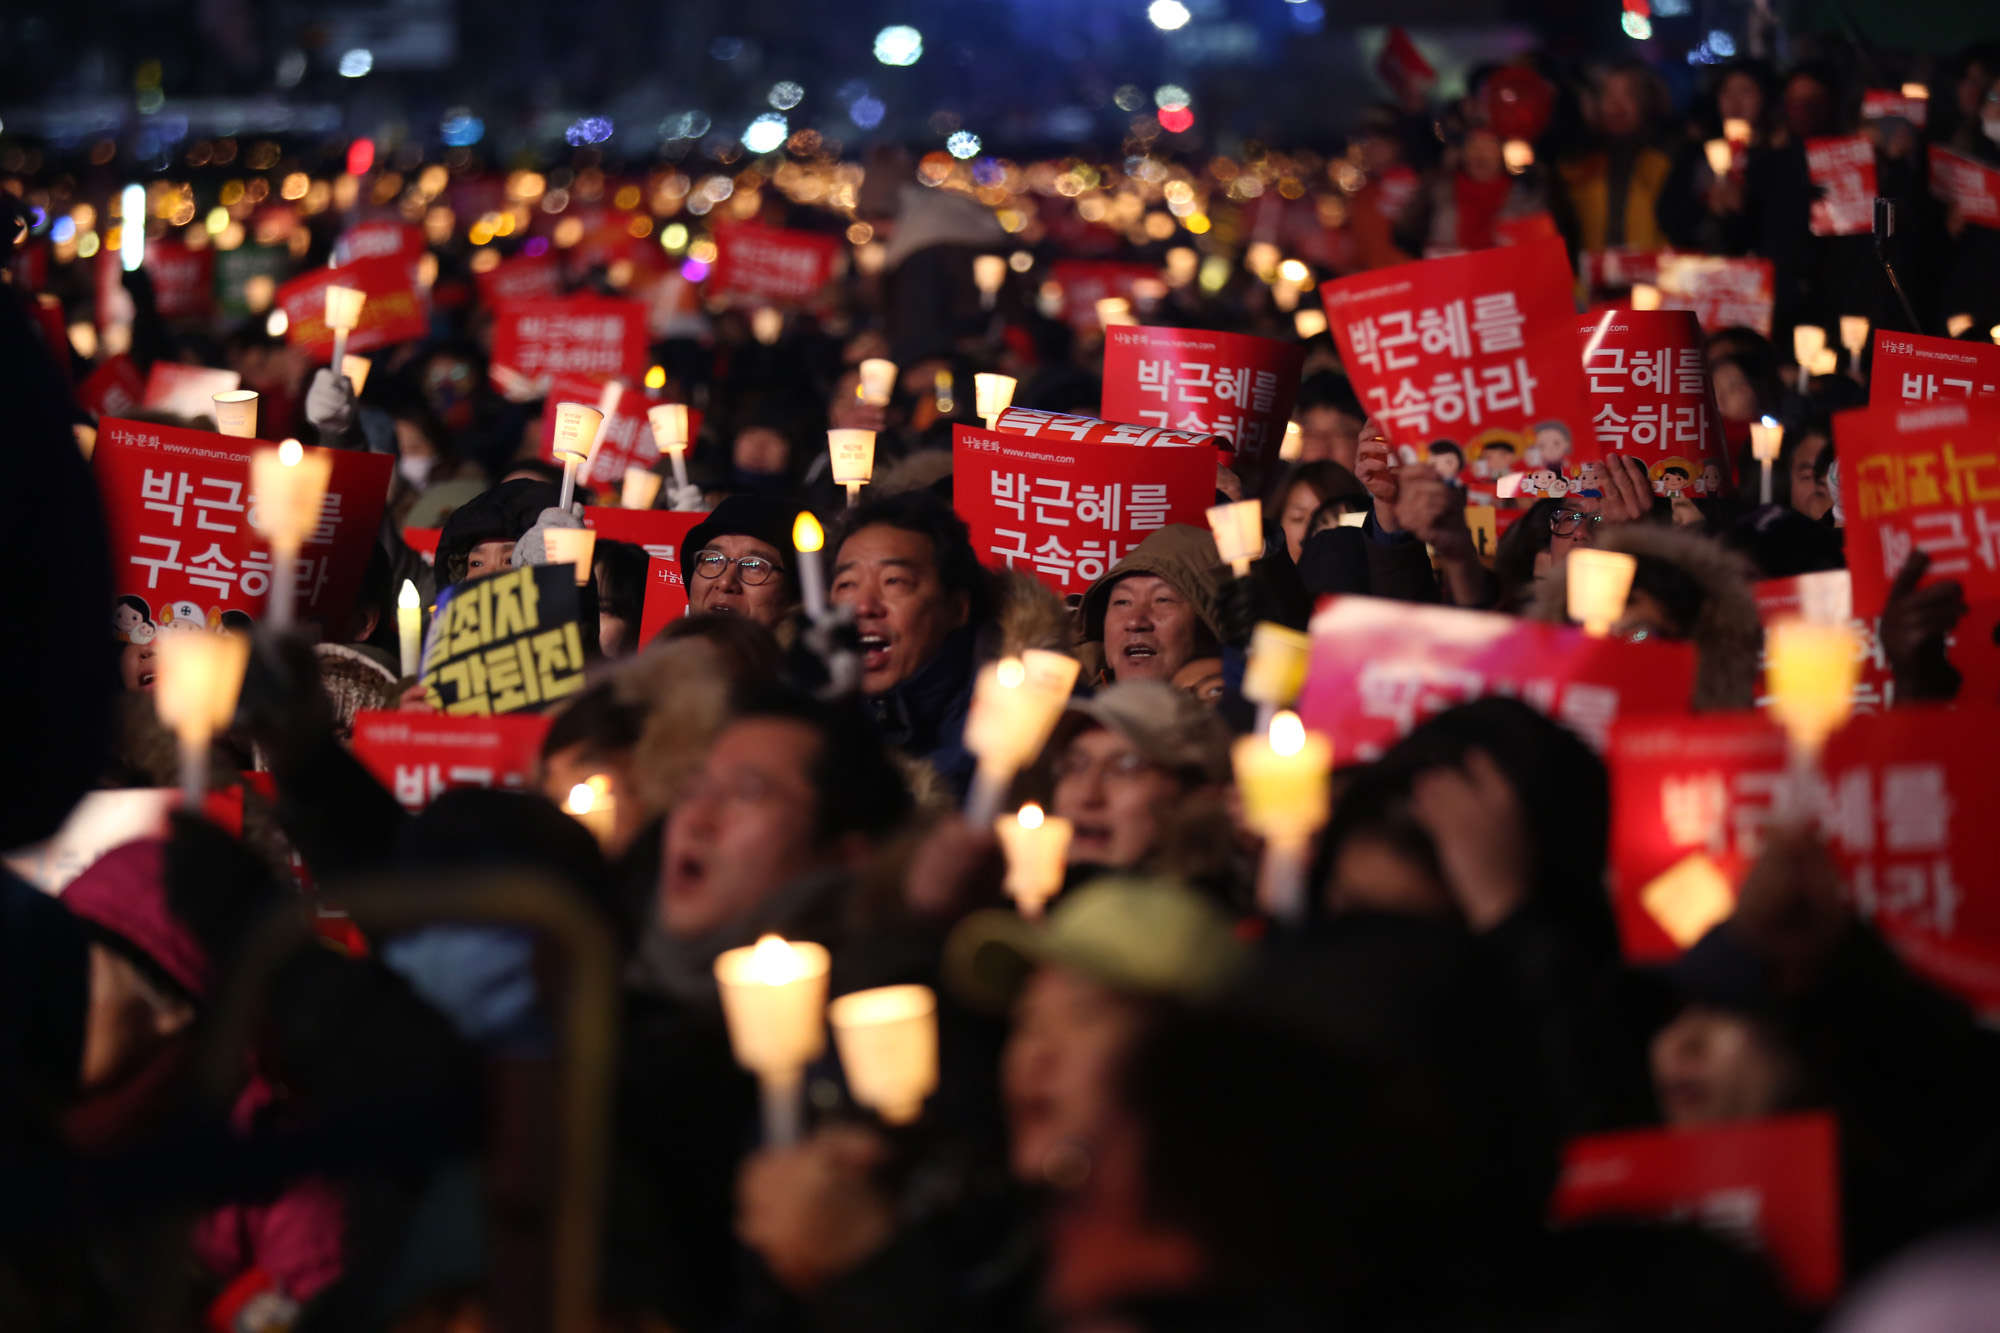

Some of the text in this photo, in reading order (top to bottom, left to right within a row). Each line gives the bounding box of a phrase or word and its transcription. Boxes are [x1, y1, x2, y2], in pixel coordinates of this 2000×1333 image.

[1348, 291, 1525, 374] 박근혜를
[1881, 340, 1977, 364] 나눔문화 www.nanum.com
[1138, 359, 1277, 413] 박근혜를
[1367, 358, 1537, 434] 구속하라
[111, 430, 251, 463] 나눔문화 www.nanum.com
[962, 436, 1075, 464] 나눔문화 www.nanum.com
[1000, 408, 1105, 441] 즉각
[1593, 403, 1709, 450] 속하라
[141, 468, 343, 545] 박근를
[991, 470, 1172, 531] 박근혜를
[991, 528, 1140, 586] 구속하
